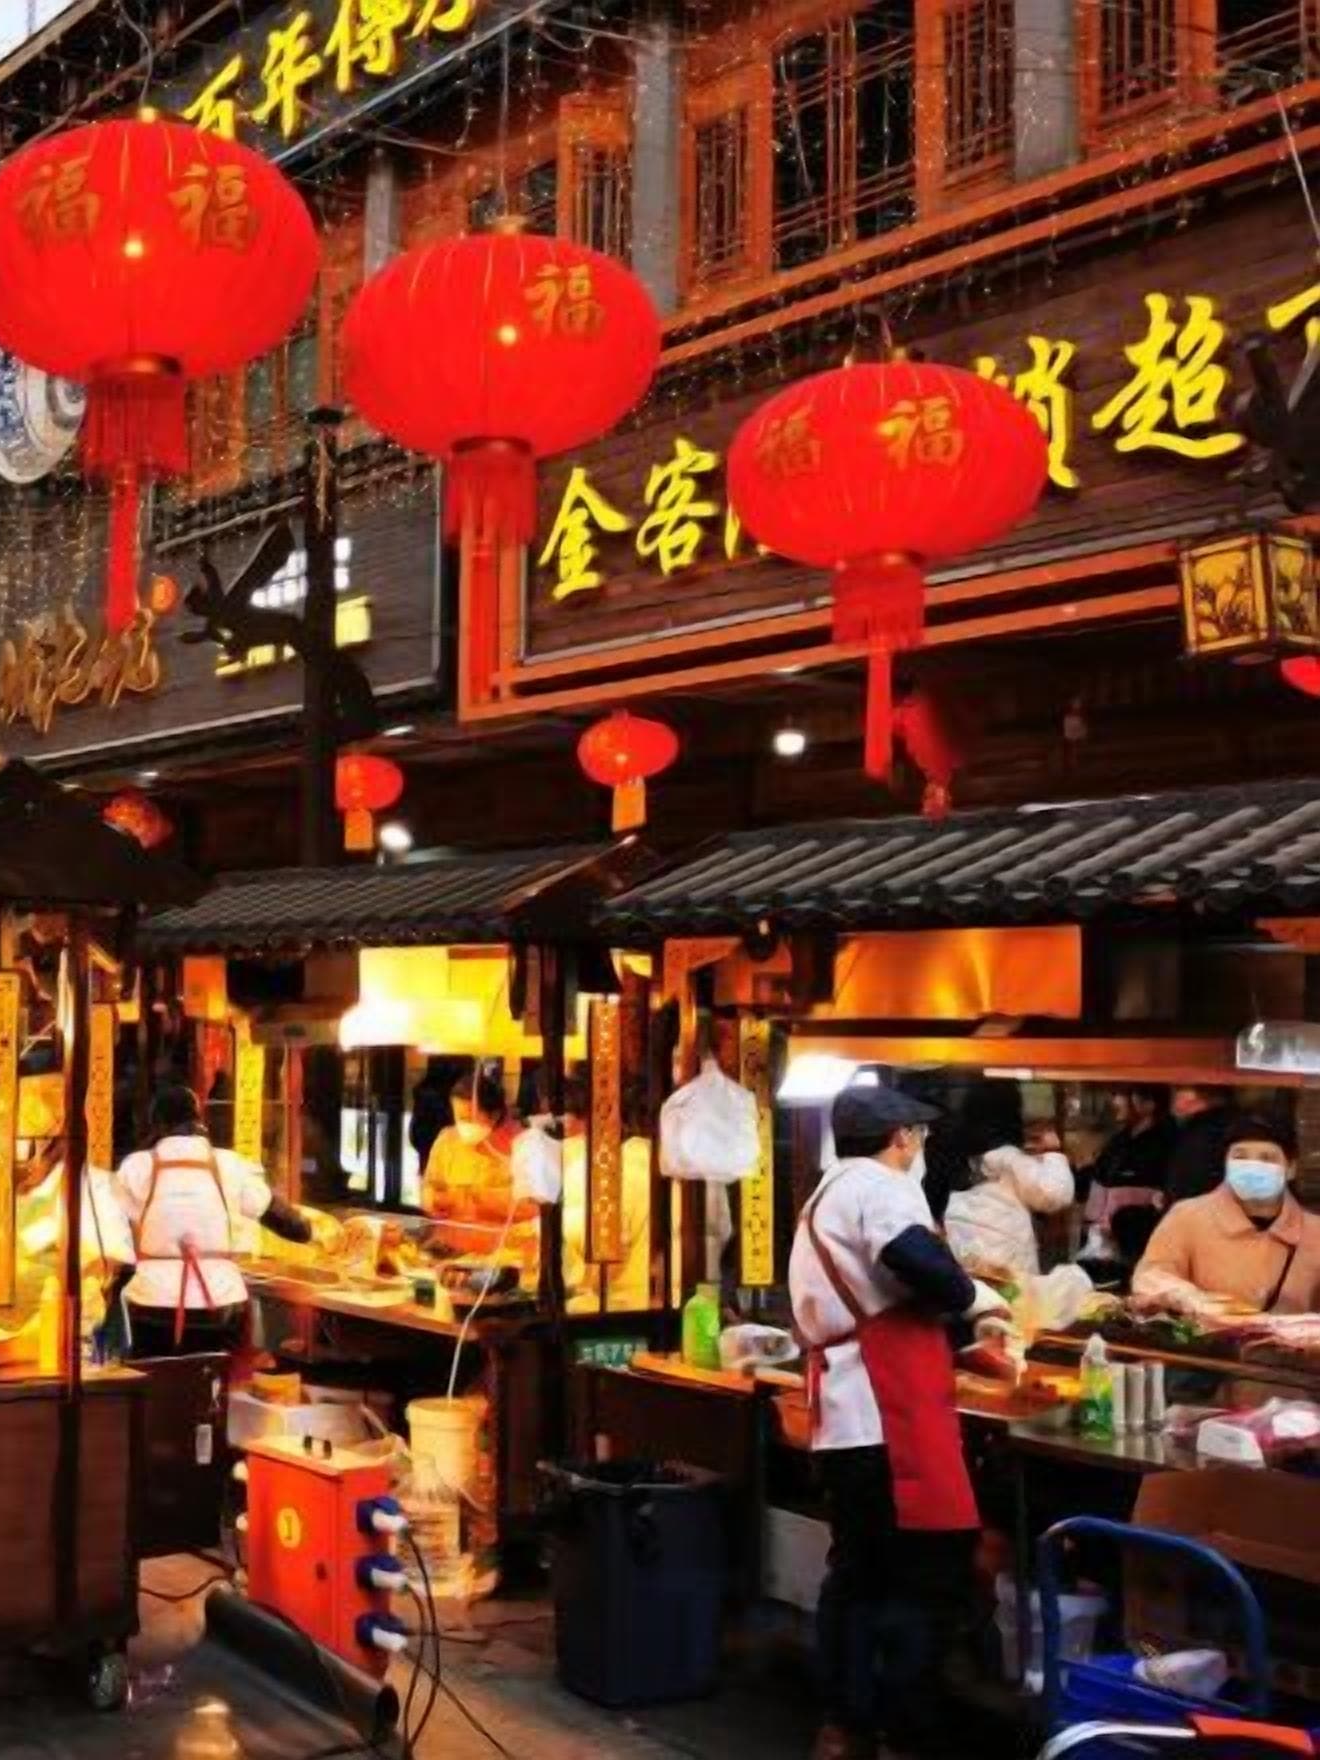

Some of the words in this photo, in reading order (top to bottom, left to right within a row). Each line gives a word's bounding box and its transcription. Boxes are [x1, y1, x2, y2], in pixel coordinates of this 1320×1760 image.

[16, 155, 101, 247] 福
[168, 163, 259, 251] 福
[523, 263, 606, 337] 福
[754, 402, 823, 476] 福
[877, 396, 964, 470] 福
